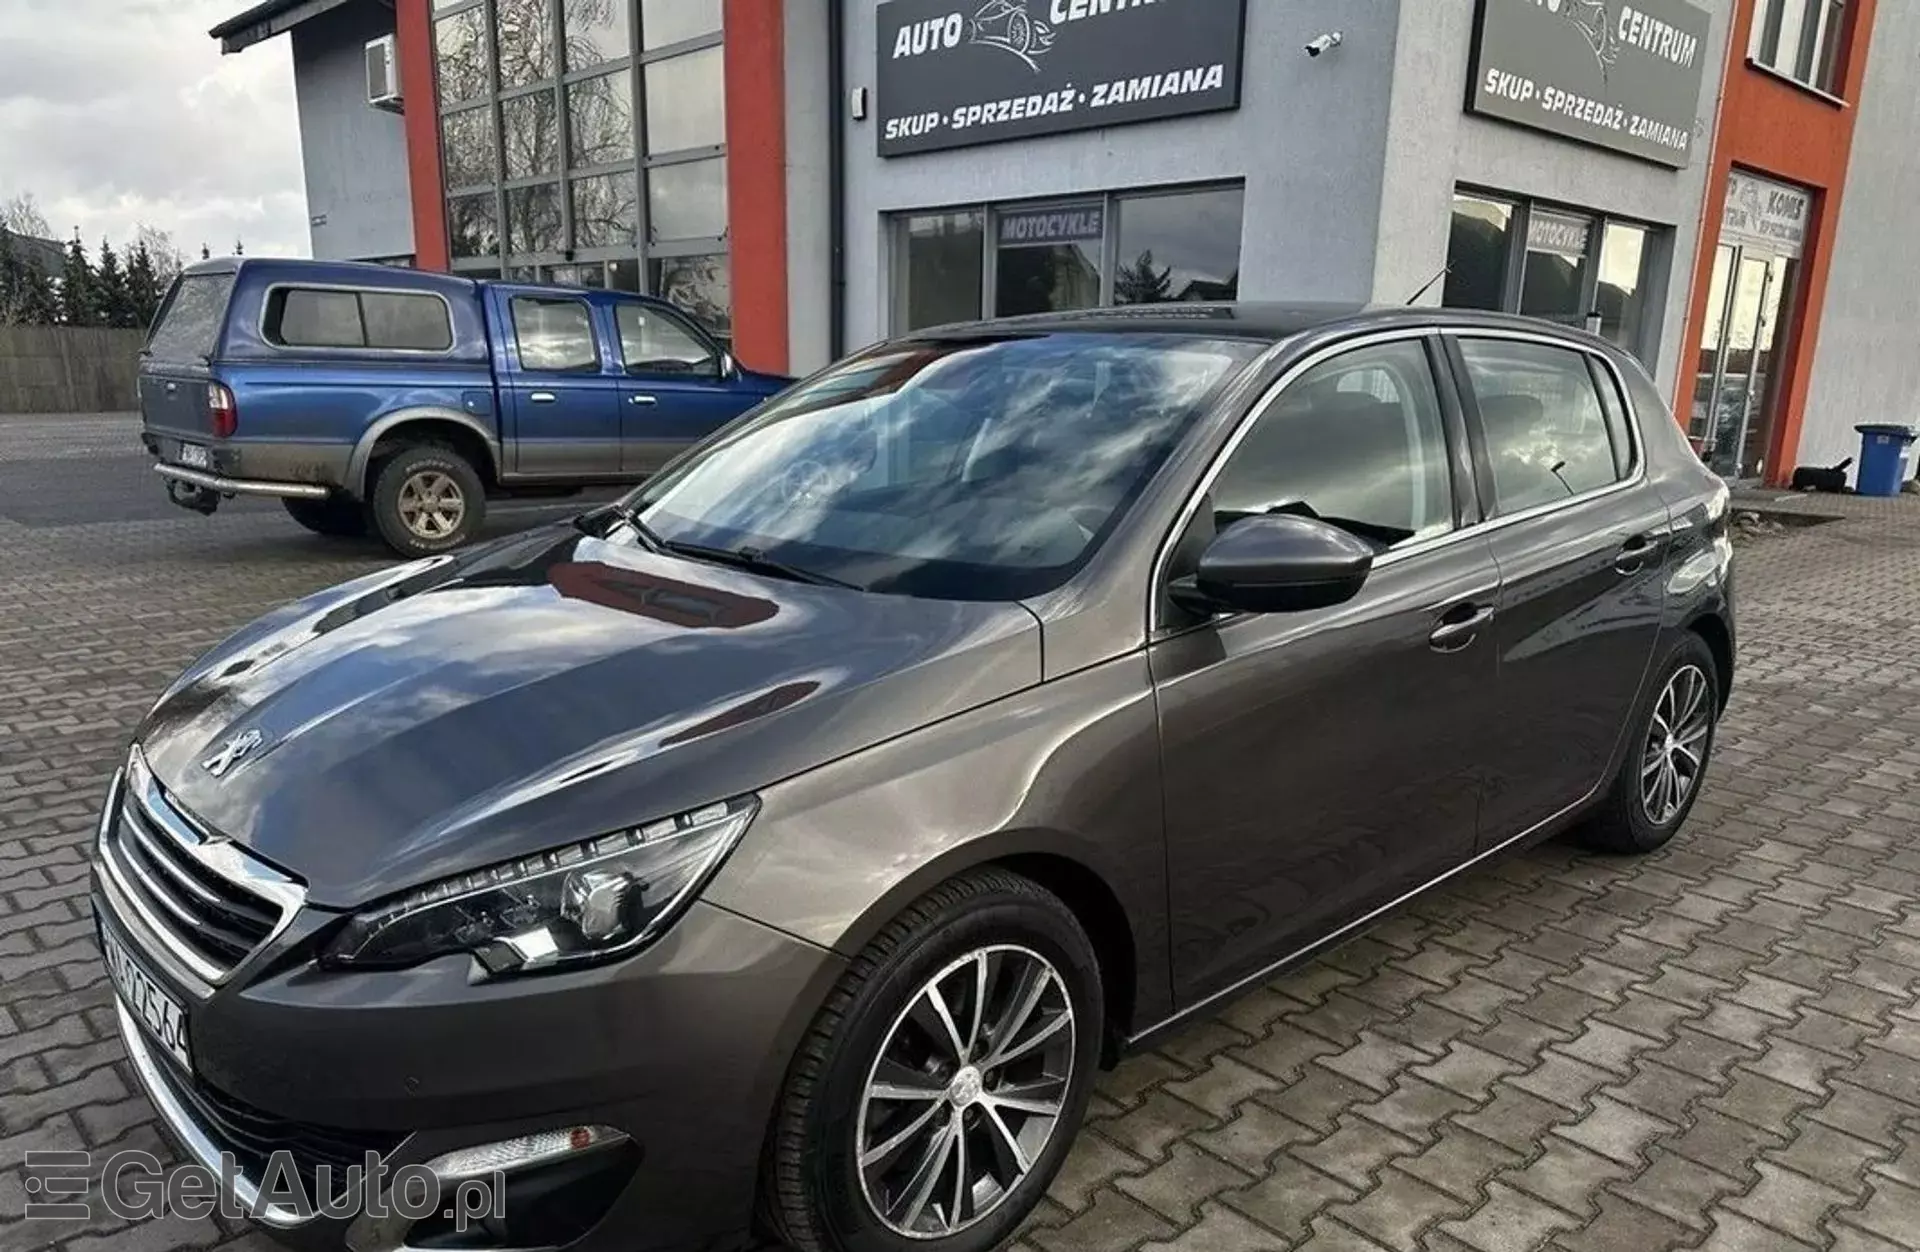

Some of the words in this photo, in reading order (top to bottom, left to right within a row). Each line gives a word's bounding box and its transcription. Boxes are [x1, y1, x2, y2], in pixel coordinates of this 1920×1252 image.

[893, 12, 963, 59] AUTO
[1618, 6, 1697, 68] CENTRUM
[885, 112, 939, 140] SKUP
[952, 82, 1076, 130] SPRZEDAŻ
[1090, 64, 1224, 108] ZAMIANA
[1484, 68, 1534, 102] SKUP
[1541, 86, 1624, 131] SPRZEDAŻ
[1629, 115, 1689, 150] ZAMIANA
[1002, 209, 1101, 240] MOTOCYKLE
